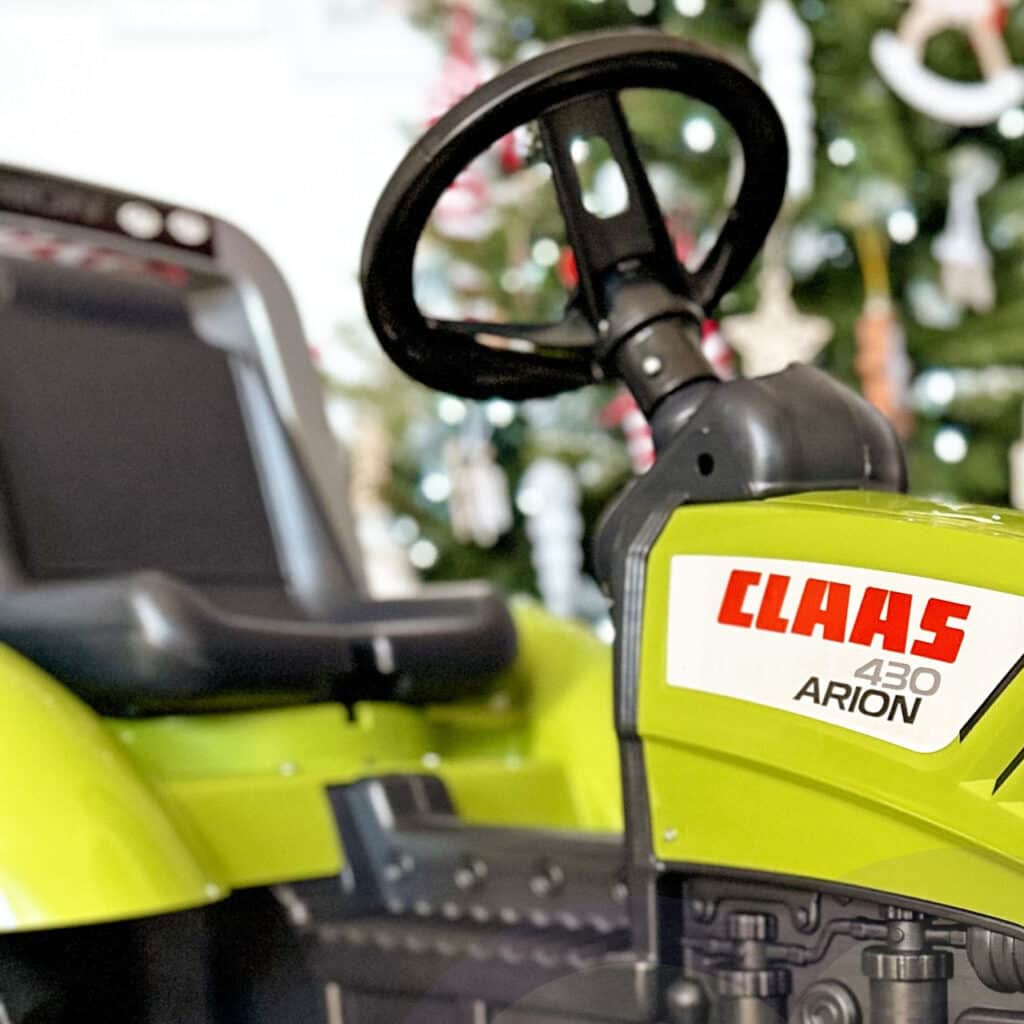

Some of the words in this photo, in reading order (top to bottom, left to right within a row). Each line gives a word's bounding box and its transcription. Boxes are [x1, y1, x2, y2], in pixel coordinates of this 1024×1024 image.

[716, 569, 972, 664] CLAAS
[793, 676, 922, 725] ARION
[853, 658, 942, 697] 430
